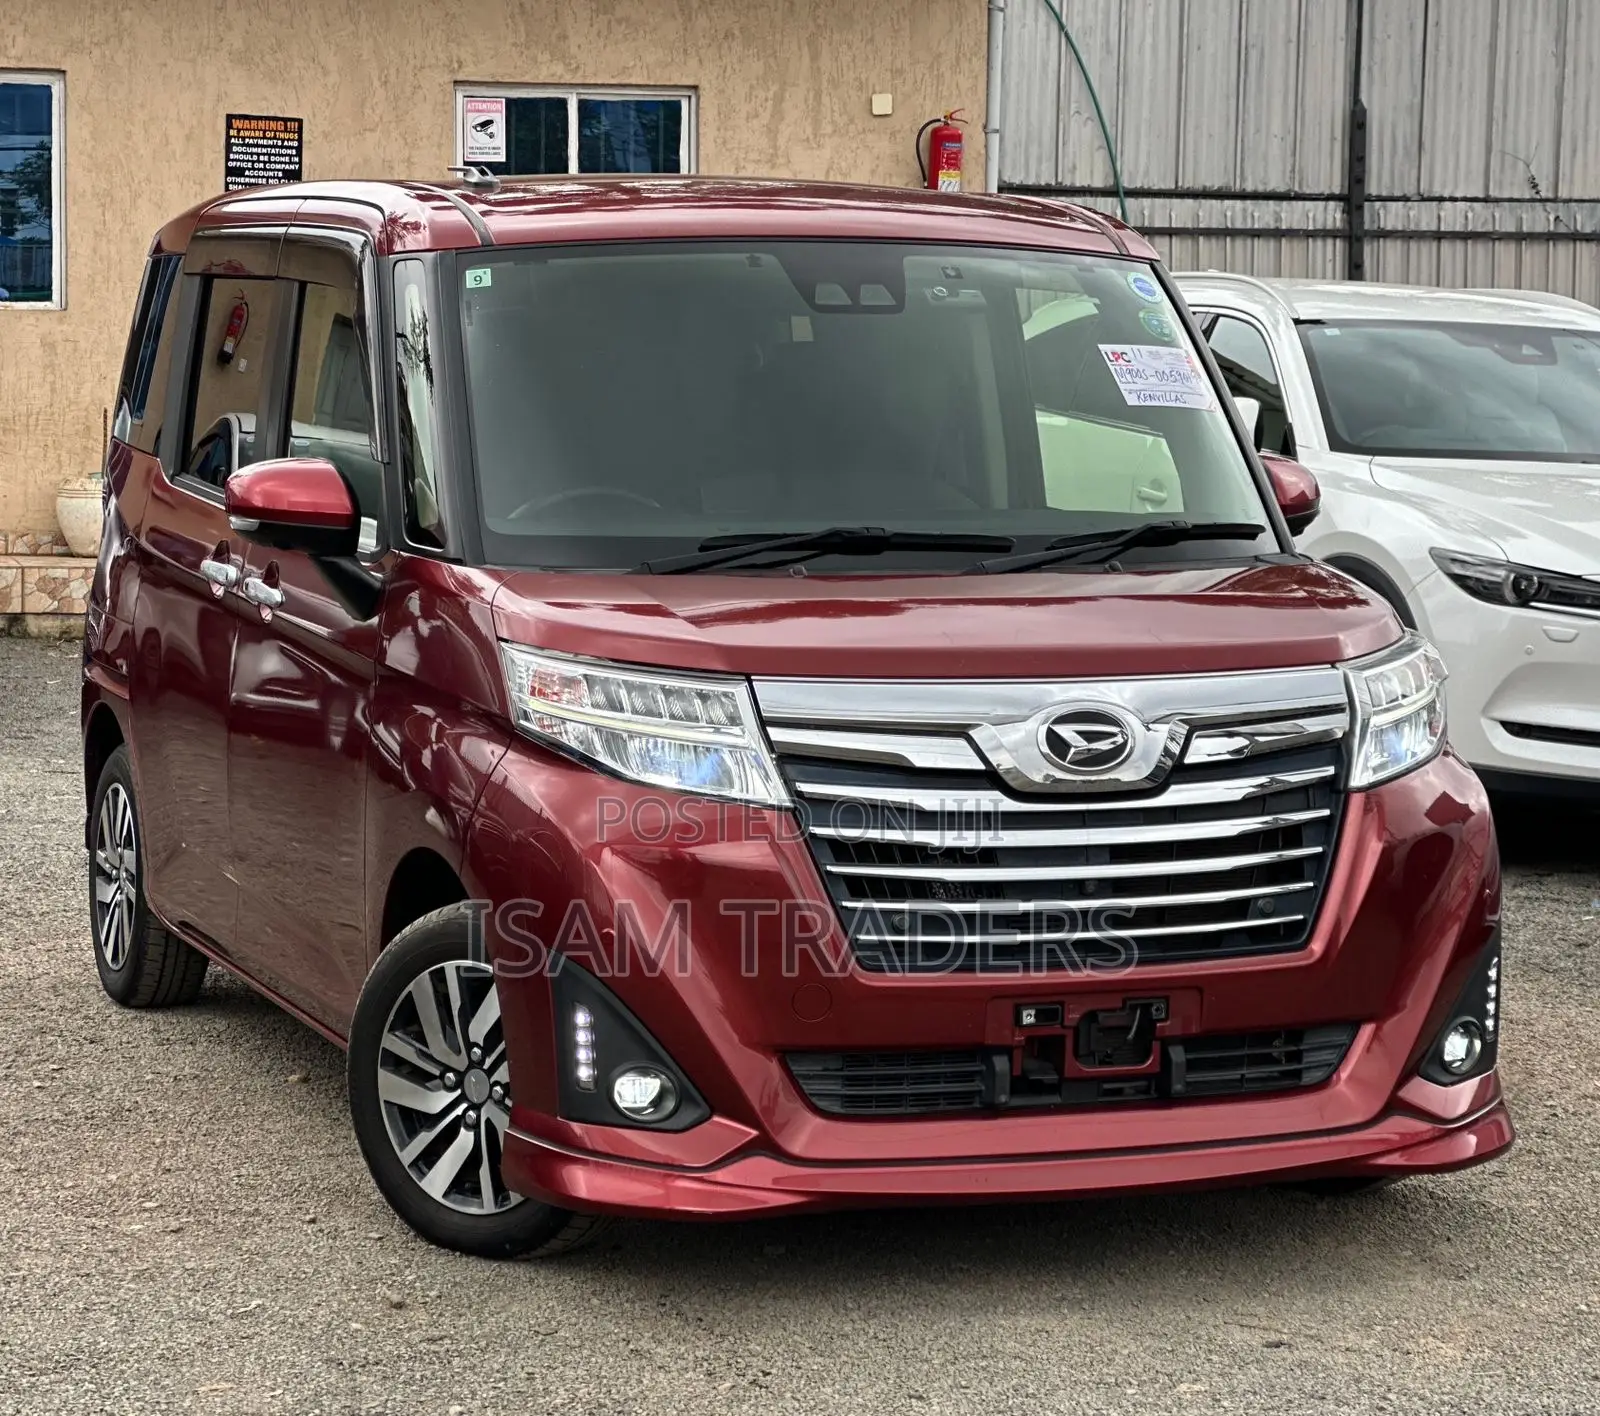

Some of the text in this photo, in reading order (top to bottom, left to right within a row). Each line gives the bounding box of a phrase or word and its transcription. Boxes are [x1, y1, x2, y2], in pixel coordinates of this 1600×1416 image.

[467, 102, 502, 111] ATTENTION
[232, 119, 298, 131] WARNING !!!
[245, 138, 281, 146] PAYMENTS
[232, 146, 296, 155] DOCUMENTATIONS
[474, 275, 483, 285] 9
[1105, 351, 1132, 363] LPC
